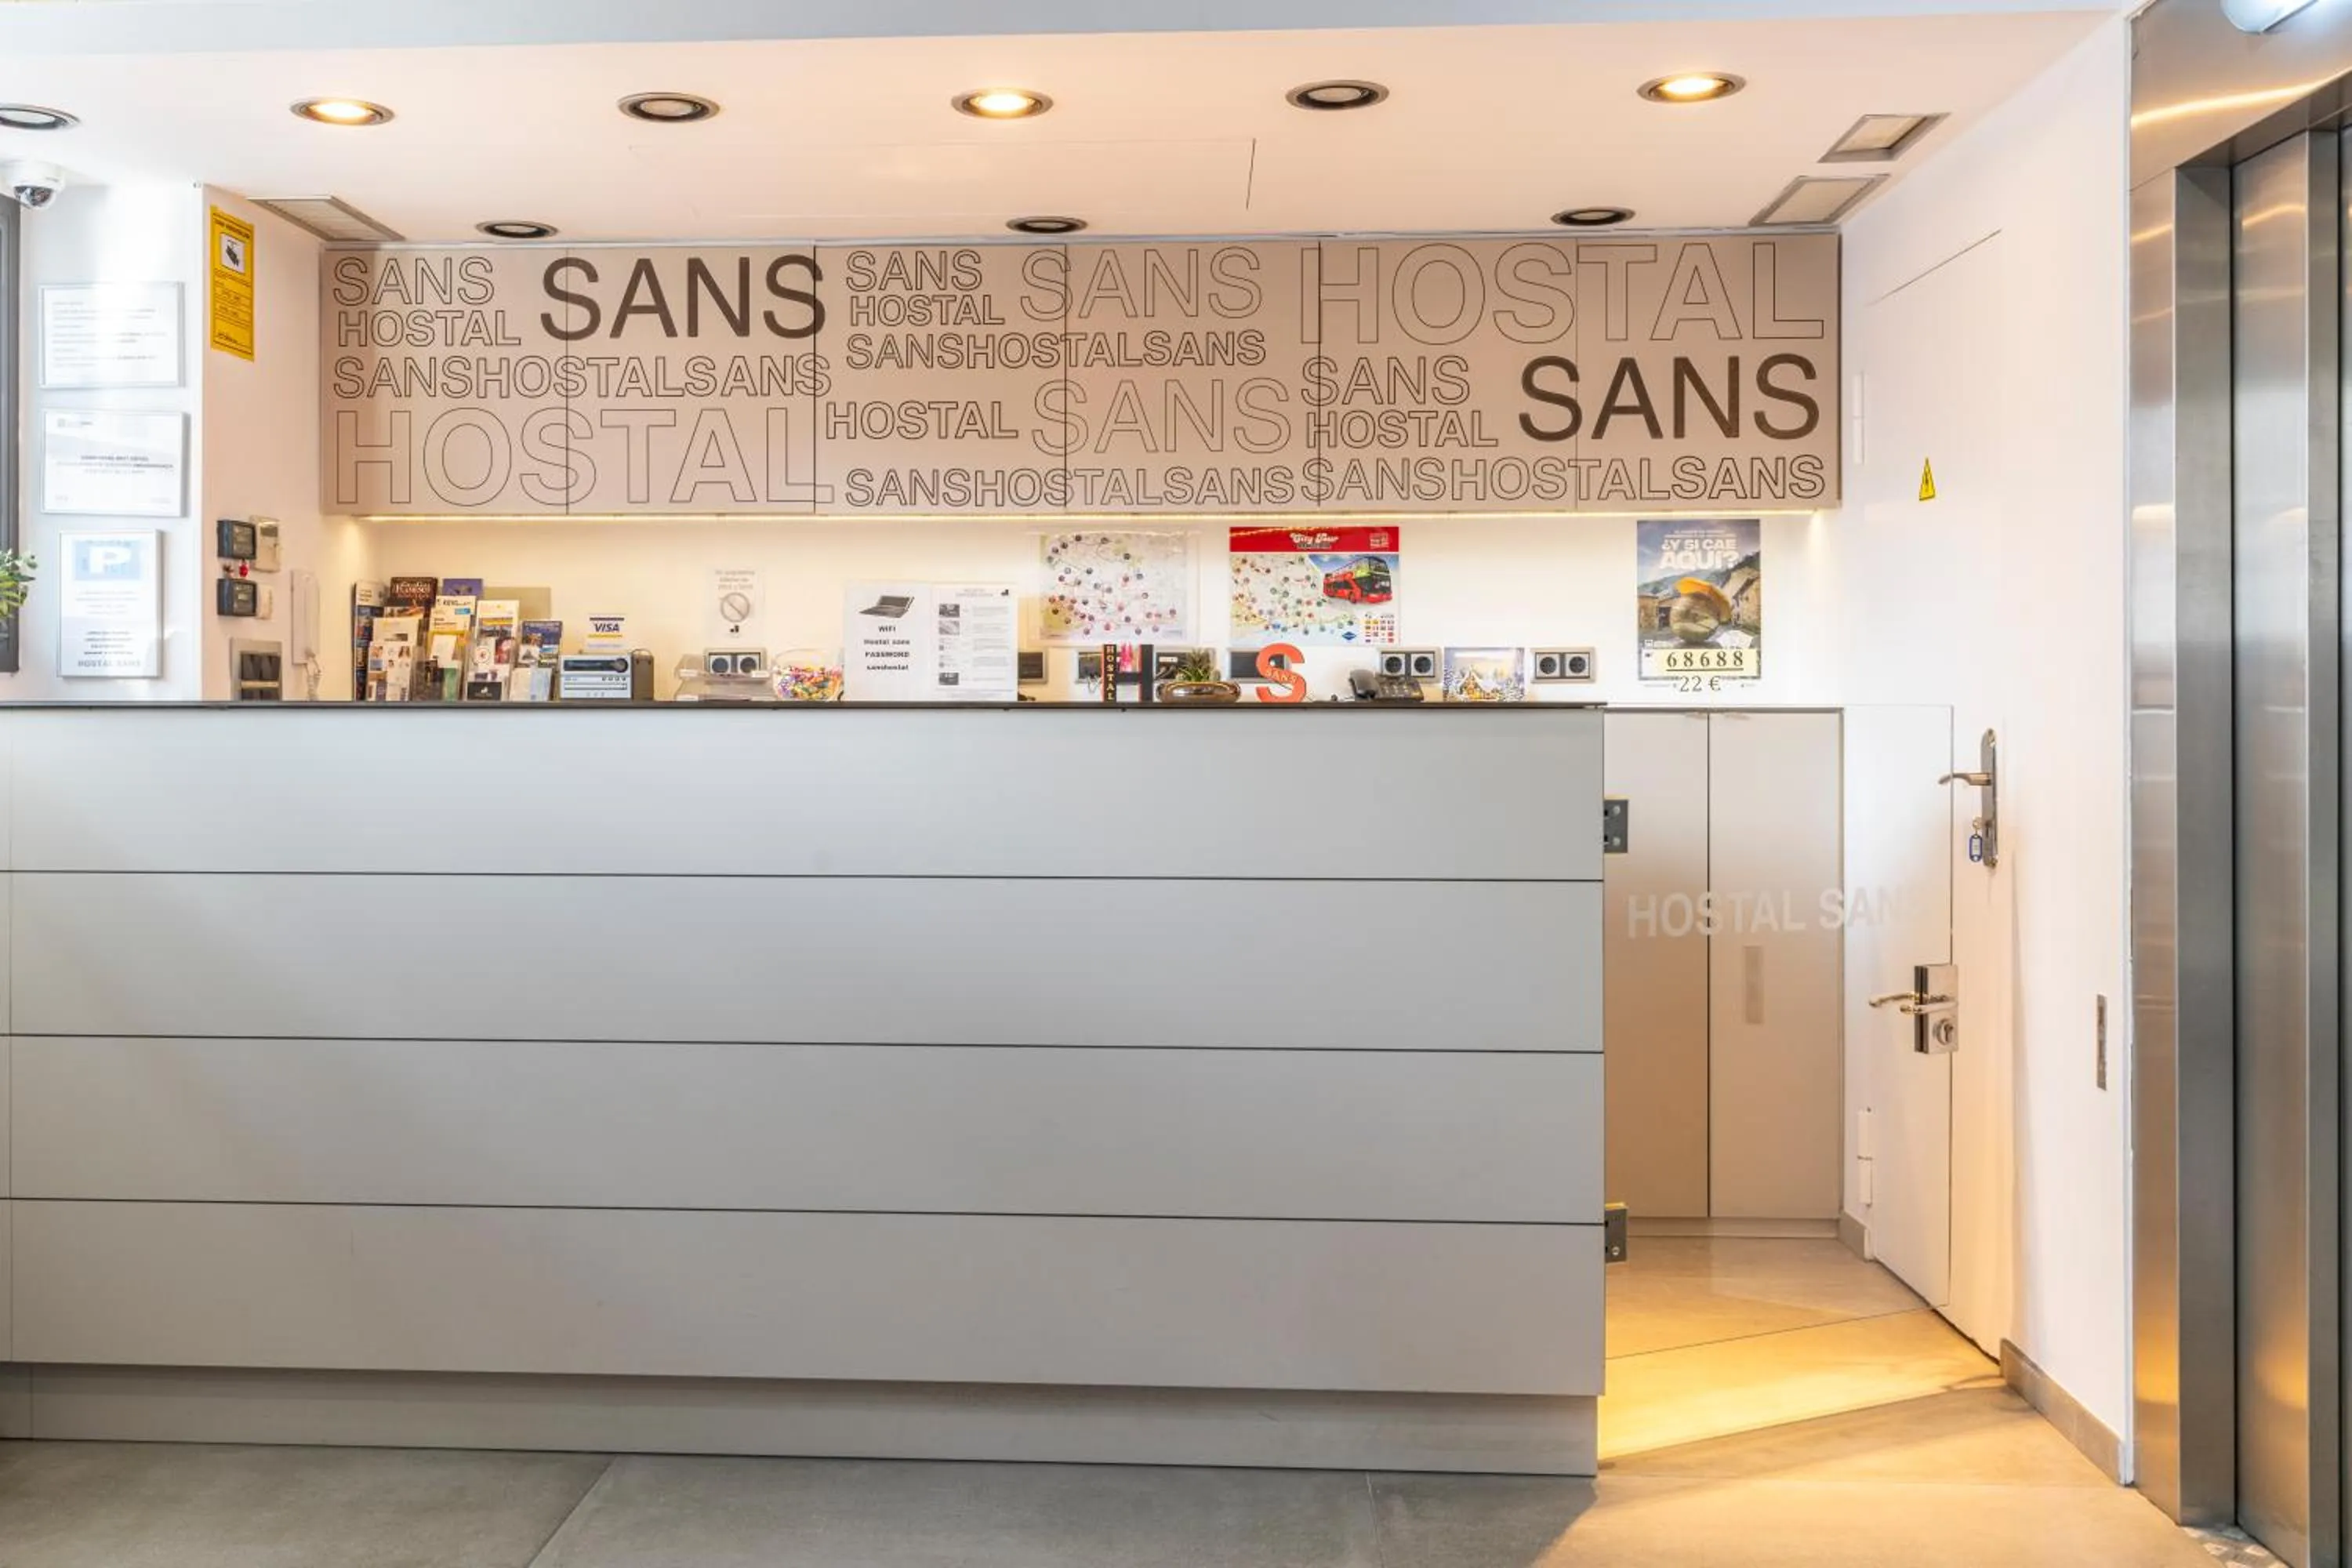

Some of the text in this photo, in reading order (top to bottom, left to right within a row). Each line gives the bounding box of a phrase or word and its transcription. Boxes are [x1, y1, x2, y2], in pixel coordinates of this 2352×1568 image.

[333, 257, 495, 306] SANS
[846, 251, 982, 291] SANS
[1020, 246, 1262, 321] SANS
[1301, 242, 1824, 345] HOSTAL
[540, 255, 826, 340] SANS
[850, 294, 1005, 326] HOSTAL
[338, 310, 521, 347] HOSTAL
[1301, 355, 1470, 406] SANS
[1519, 354, 1820, 441] SANS
[826, 401, 1018, 439] HOSTAL
[1032, 378, 1291, 456] SANS
[1306, 410, 1498, 448] HOSTAL
[337, 407, 834, 506] HOSTAL
[89, 546, 132, 573] P
[1685, 539, 1699, 550] SI
[1702, 539, 1737, 550] CAE
[594, 623, 620, 632] VISA
[1106, 645, 1115, 700] HOSTAL
[1255, 643, 1307, 702] S
[1679, 676, 1722, 692] 22 €
[1628, 884, 1913, 938] HOSTAL SAN
